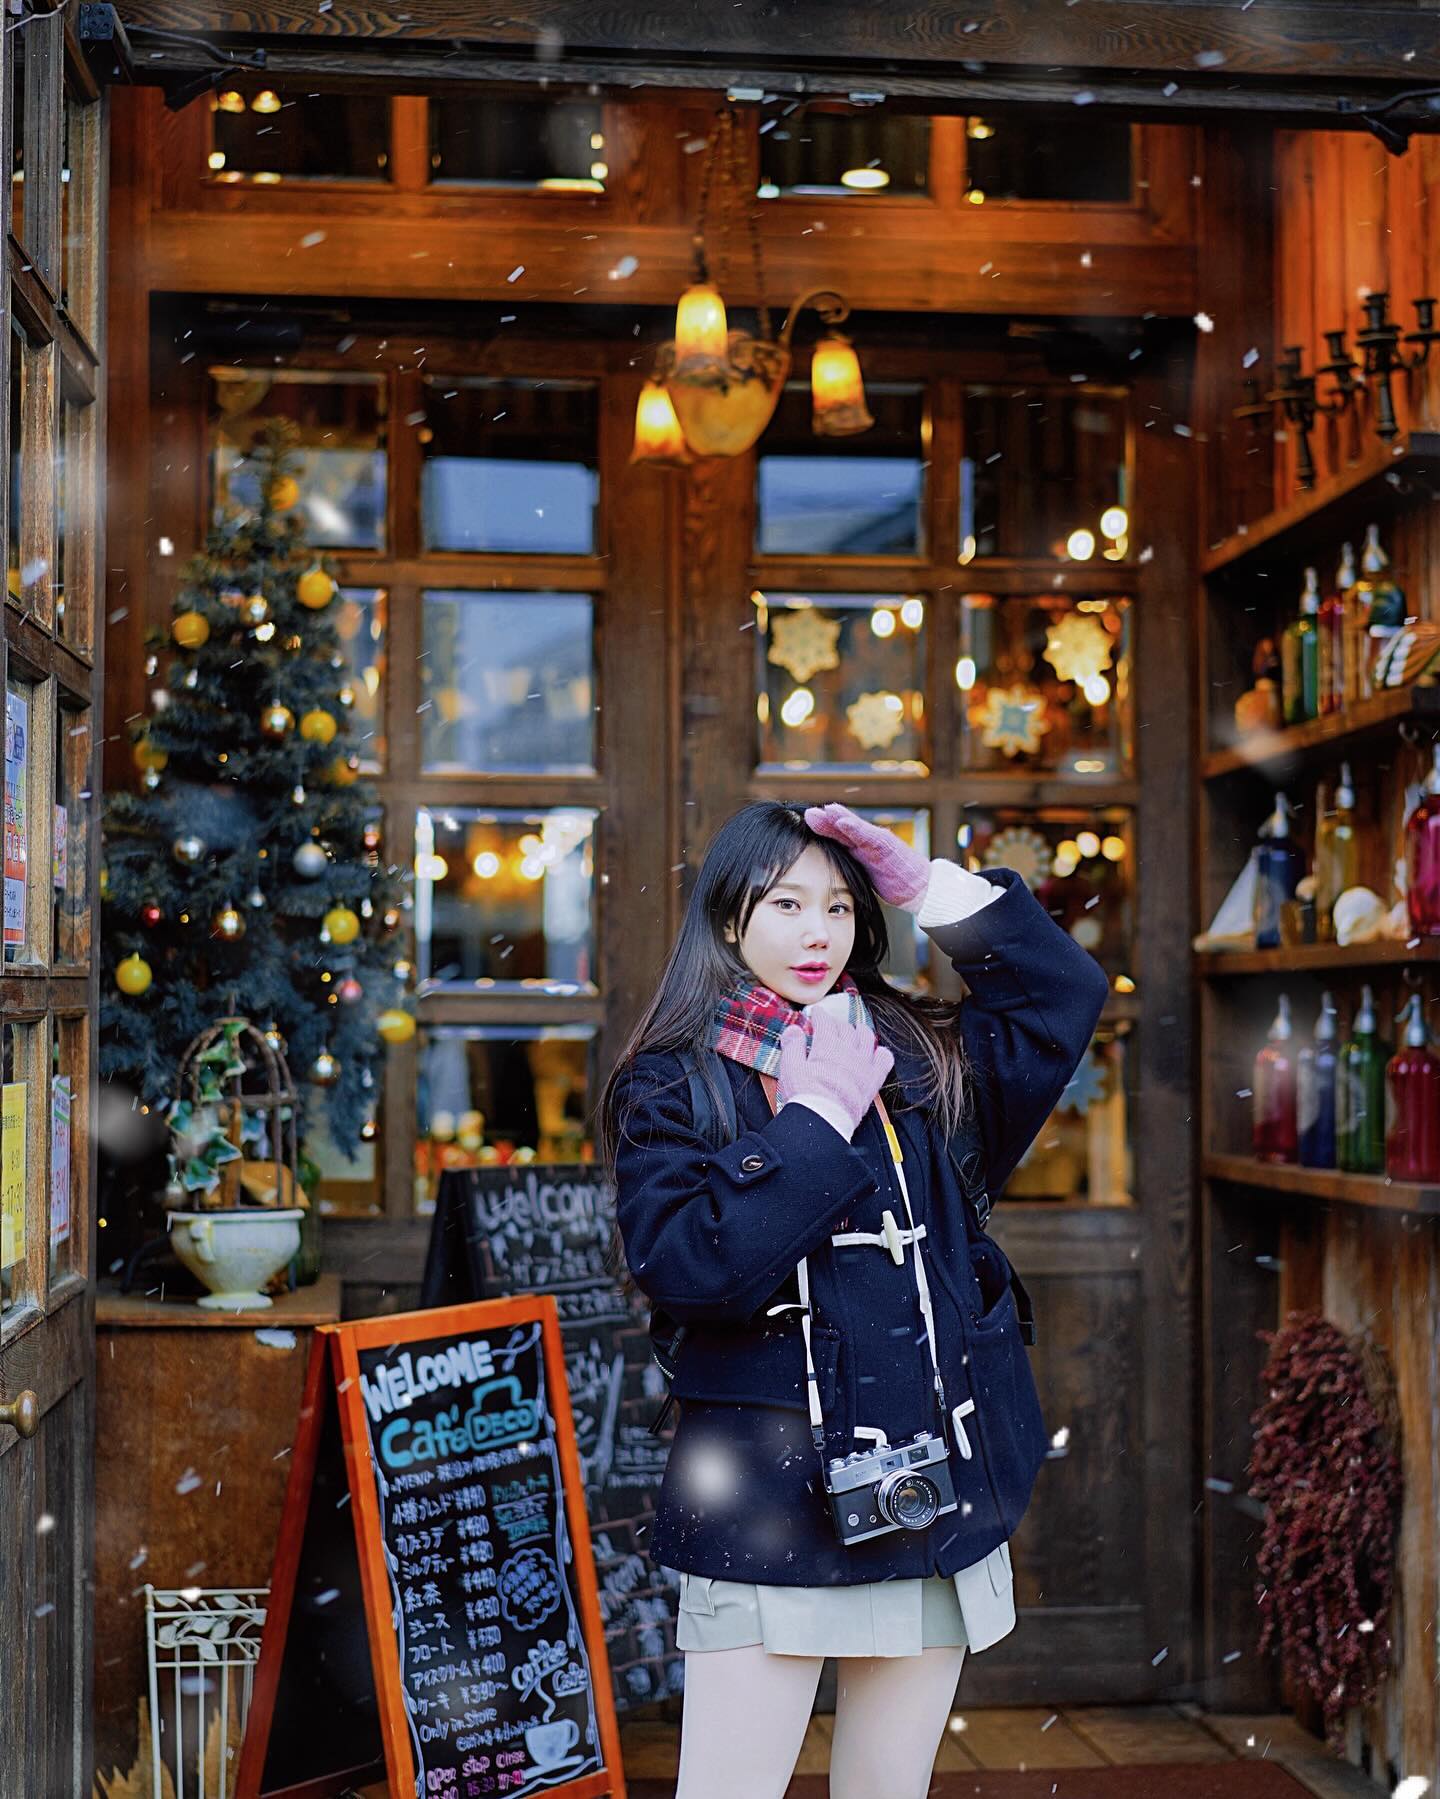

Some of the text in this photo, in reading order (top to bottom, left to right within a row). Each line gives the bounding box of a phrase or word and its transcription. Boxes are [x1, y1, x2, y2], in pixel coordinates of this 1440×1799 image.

[359, 1340, 495, 1422] WELCOME
[472, 1407, 533, 1441] DECO
[401, 1553, 455, 1580] ミルクティー
[404, 1581, 443, 1614] 紅茶
[408, 1612, 451, 1639] ジュース
[408, 1635, 456, 1664] フロート
[409, 1659, 473, 1692] アイスクリーム
[417, 1691, 450, 1717] ケーキ
[420, 1718, 449, 1743] Only
